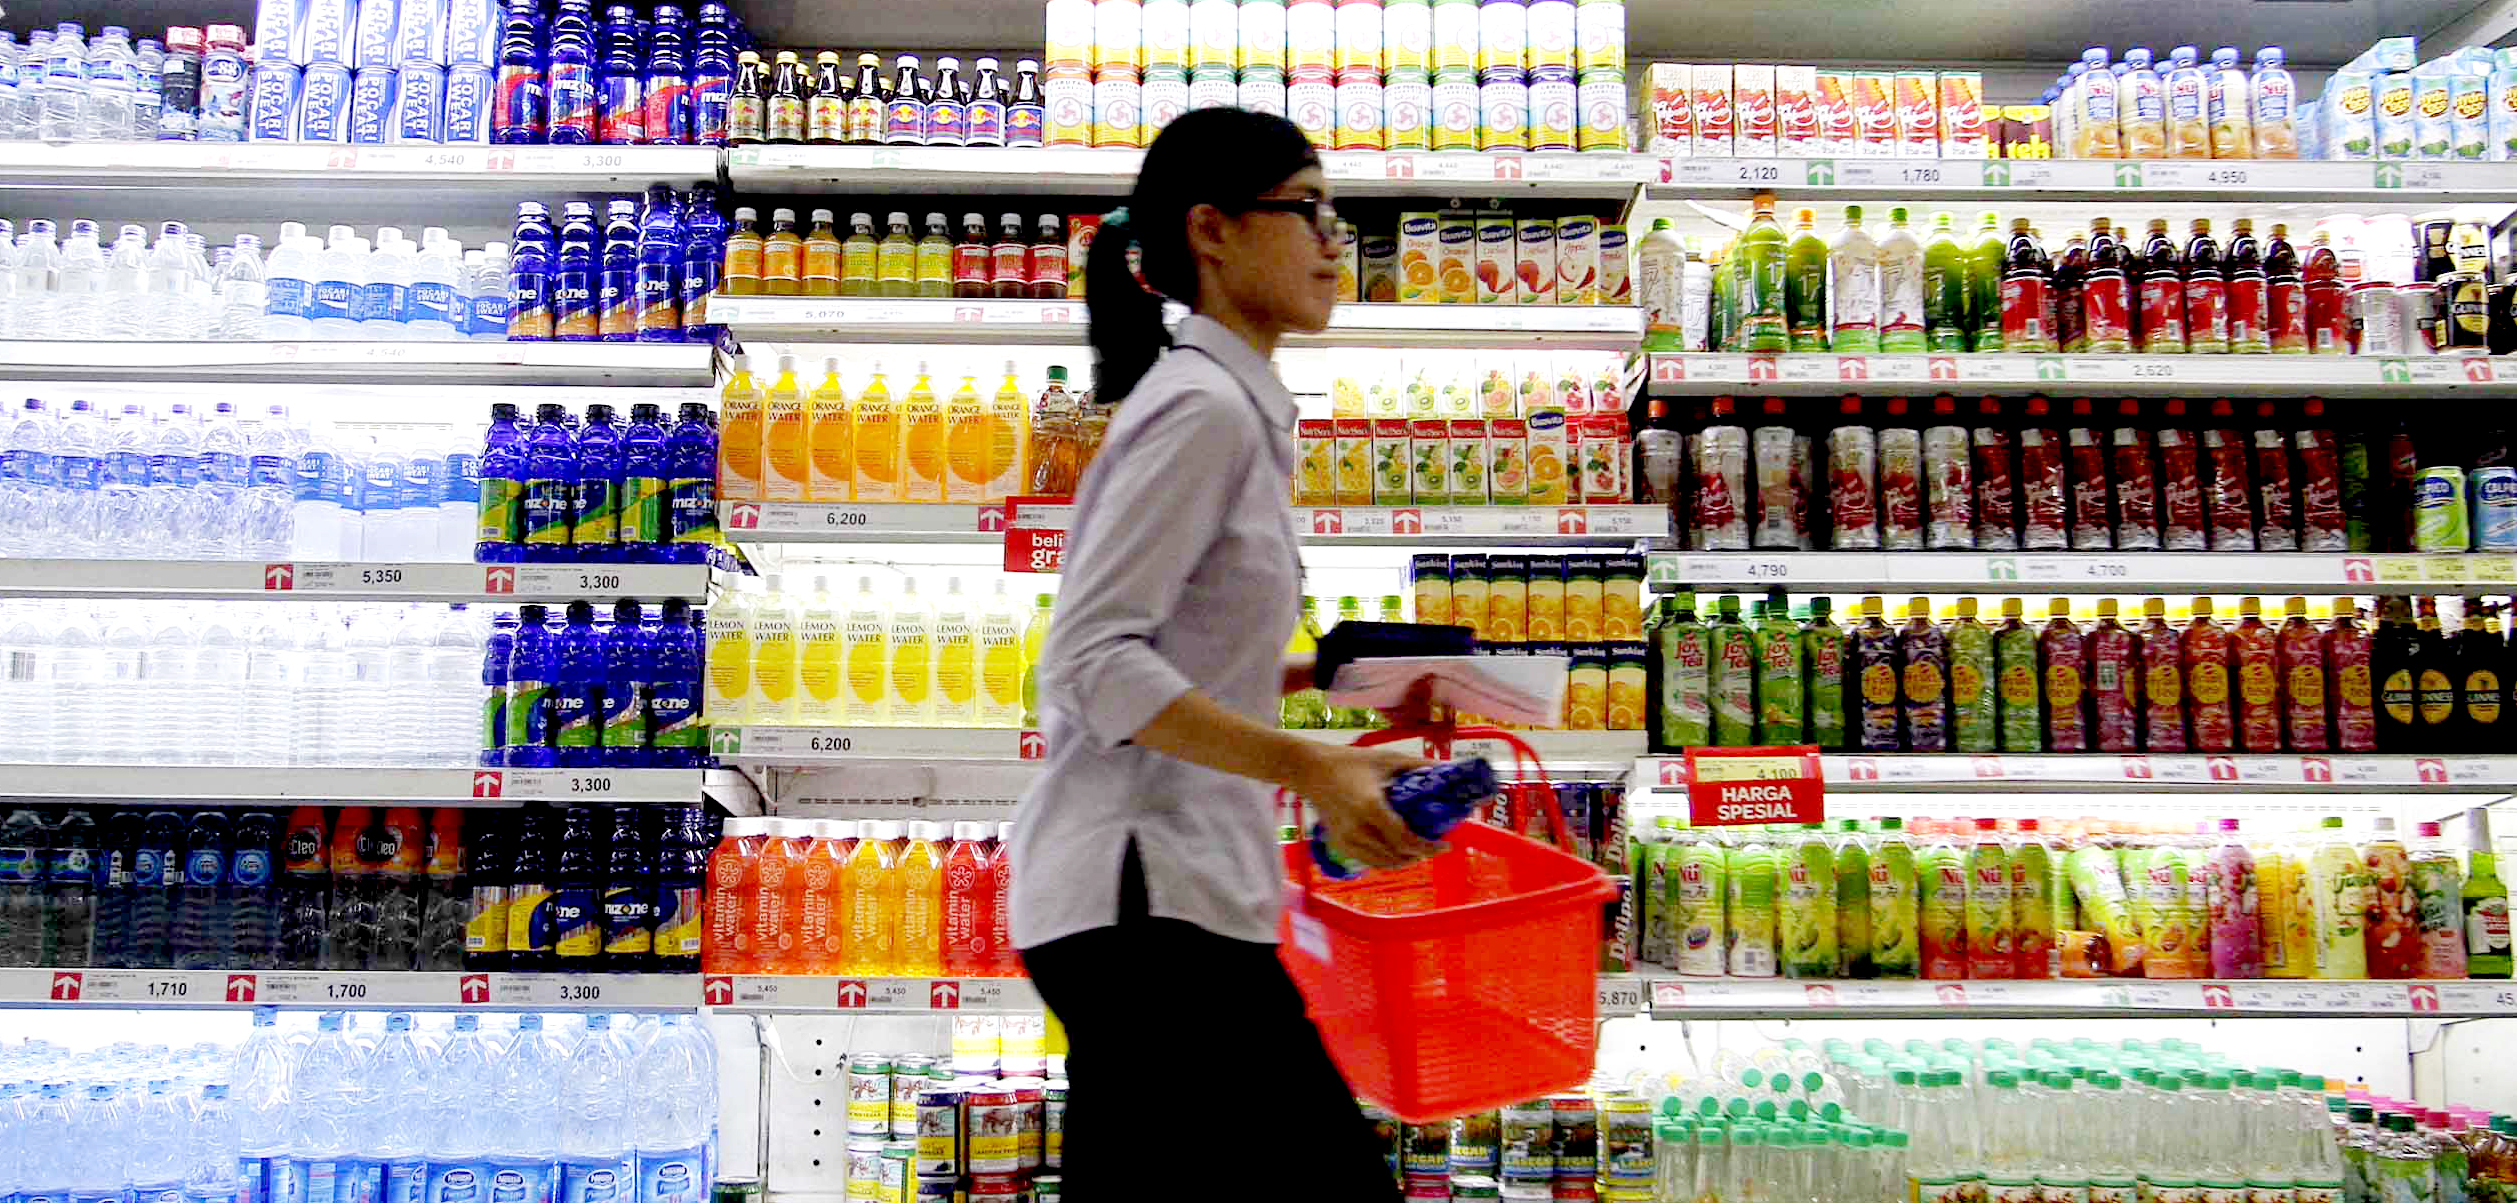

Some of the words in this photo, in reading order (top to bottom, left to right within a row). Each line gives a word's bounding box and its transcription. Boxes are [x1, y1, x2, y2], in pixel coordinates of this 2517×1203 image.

[257, 71, 273, 130] SWEAT
[267, 71, 285, 137] POCARI
[305, 72, 321, 132] SWEAT
[317, 72, 332, 138] POCARI
[405, 70, 421, 134] SWEAT
[415, 71, 432, 137] POCARI
[449, 73, 463, 132] SWEAT
[457, 72, 474, 139] POCARI
[355, 76, 369, 138] SWEAT
[364, 76, 380, 143] POCARI
[425, 154, 465, 166] 4,540
[583, 154, 622, 167] 3,300
[1739, 167, 1778, 181] 2,120
[1902, 169, 1940, 183] 1,780
[2208, 170, 2248, 184] 4,950
[804, 310, 845, 320] 5,070
[723, 400, 760, 411] ORANGE
[768, 400, 802, 411] ORANGE
[812, 400, 846, 411] ORANGE
[857, 402, 890, 413] ORANGE
[906, 403, 940, 414] ORANGE
[947, 405, 981, 415] ORANGE
[992, 403, 1021, 412] ORANGE
[725, 410, 758, 422] WATER
[768, 411, 801, 423] WATER
[812, 411, 845, 423] WATER
[857, 413, 890, 424] WATER
[907, 414, 939, 425] WATER
[948, 415, 979, 426] WATER
[993, 411, 1020, 419] WATER
[827, 512, 867, 526] 6,200
[1031, 532, 1064, 548] beli
[362, 569, 402, 585] 5,350
[1747, 564, 1788, 579] 4,790
[2087, 564, 2127, 578] 4,700
[579, 574, 620, 590] 3,300
[708, 620, 744, 630] LEMON
[754, 621, 791, 632] LEMON
[800, 621, 836, 632] LEMON
[847, 623, 883, 634] LEMON
[892, 624, 925, 634] LEMON
[936, 624, 970, 634] LEMON
[982, 626, 1017, 636] LEMON
[710, 631, 743, 641] WATER
[755, 632, 790, 642] WATER
[801, 632, 835, 642] WATER
[848, 633, 882, 643] WATER
[892, 635, 924, 645] WATER
[937, 635, 970, 645] WATER
[983, 636, 1015, 646] WATER
[811, 737, 851, 752] 6,200
[571, 778, 611, 793] 3,300
[1721, 785, 1793, 803] HARGA
[1717, 803, 1798, 822] SPESIAL
[147, 981, 188, 999] 1,710
[327, 984, 367, 999] 1,700
[560, 985, 601, 1000] 3,300
